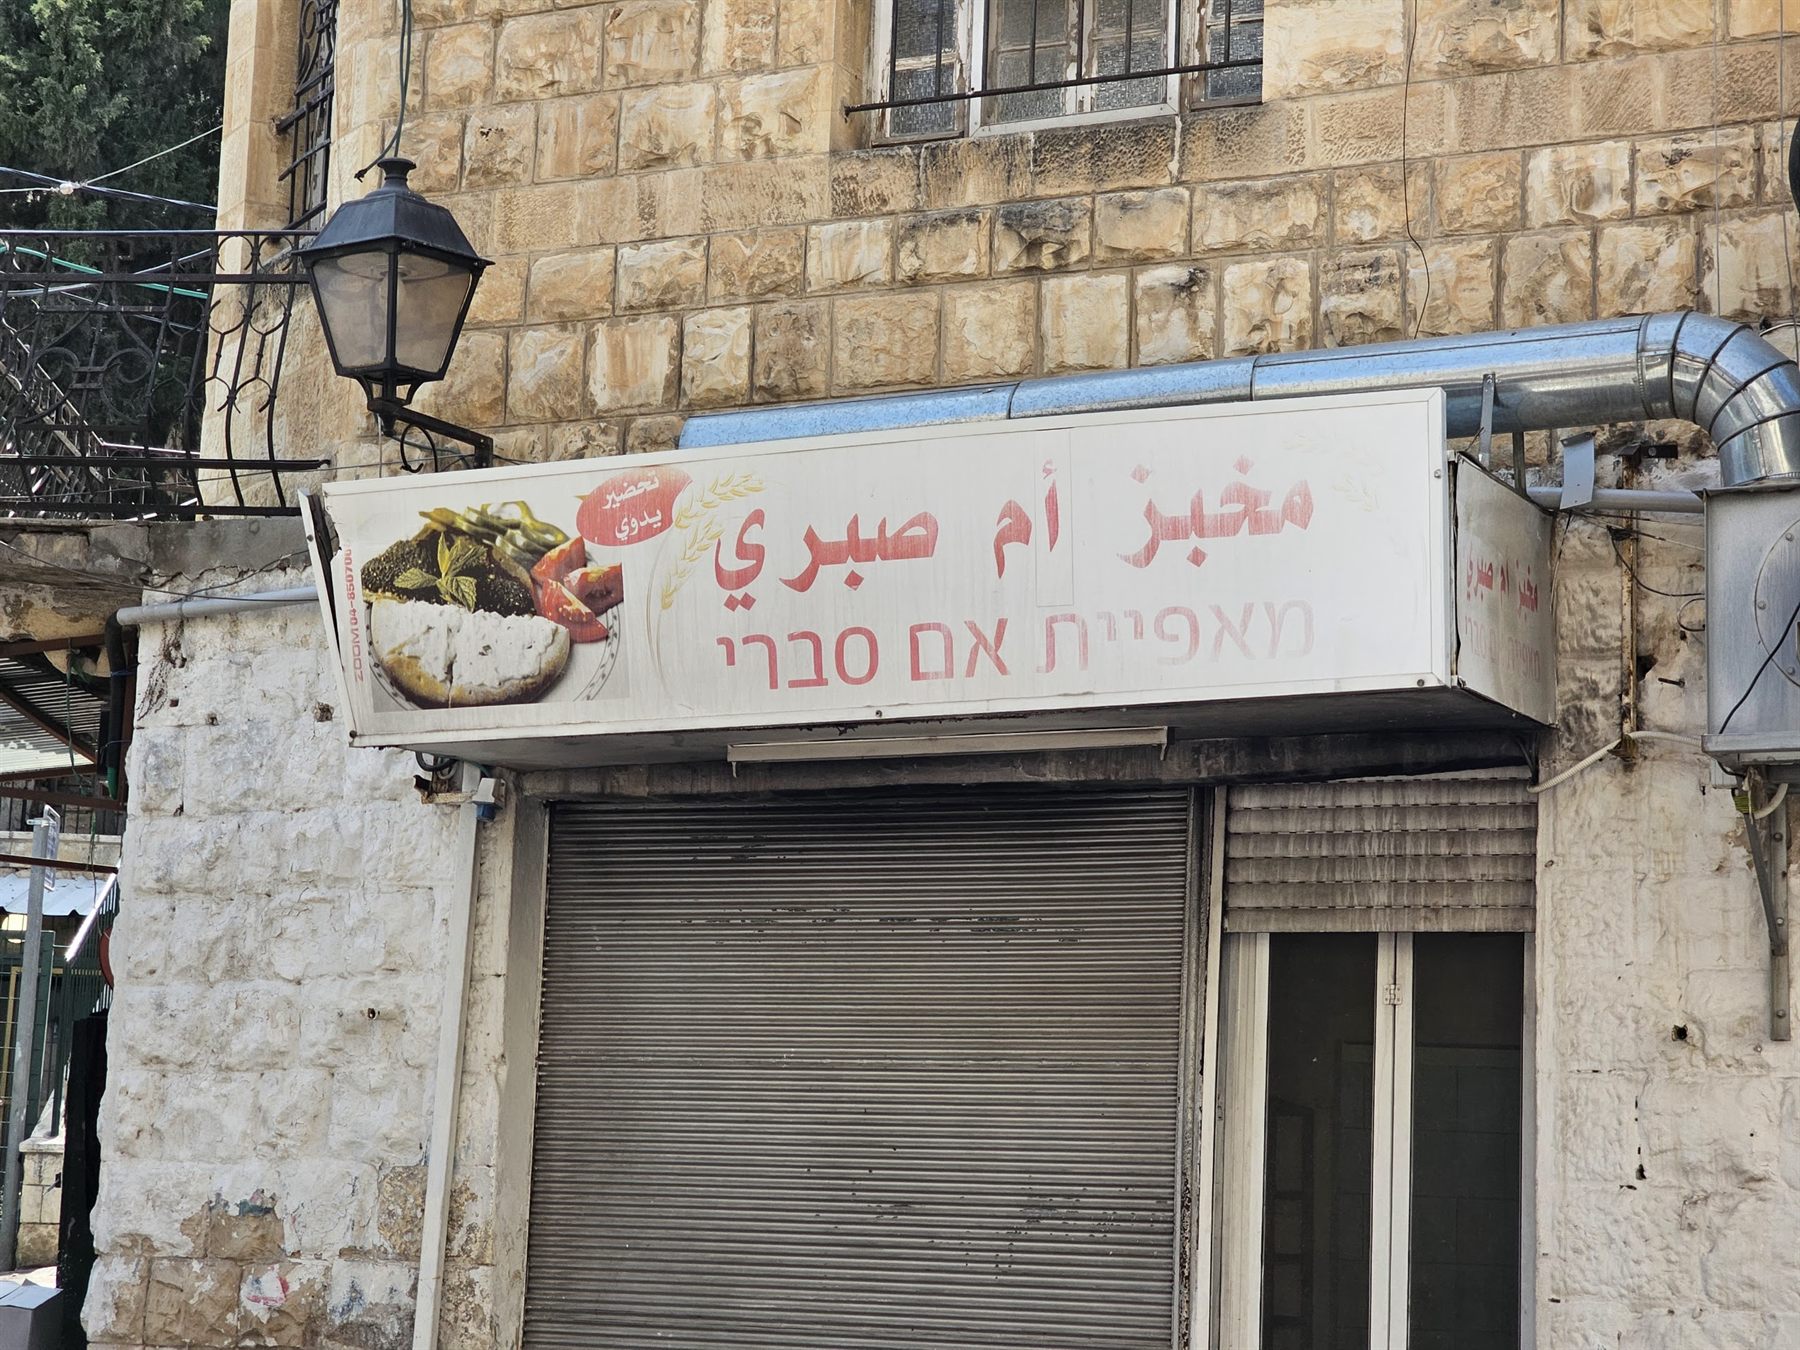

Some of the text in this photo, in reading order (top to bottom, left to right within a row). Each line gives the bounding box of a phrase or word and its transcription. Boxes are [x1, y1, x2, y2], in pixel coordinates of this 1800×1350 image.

[615, 509, 662, 540] يدوي
[714, 454, 1314, 612] مخبز أم صبري
[351, 628, 364, 683] ZOOM
[716, 599, 1315, 690] מאפיית אם סברי
